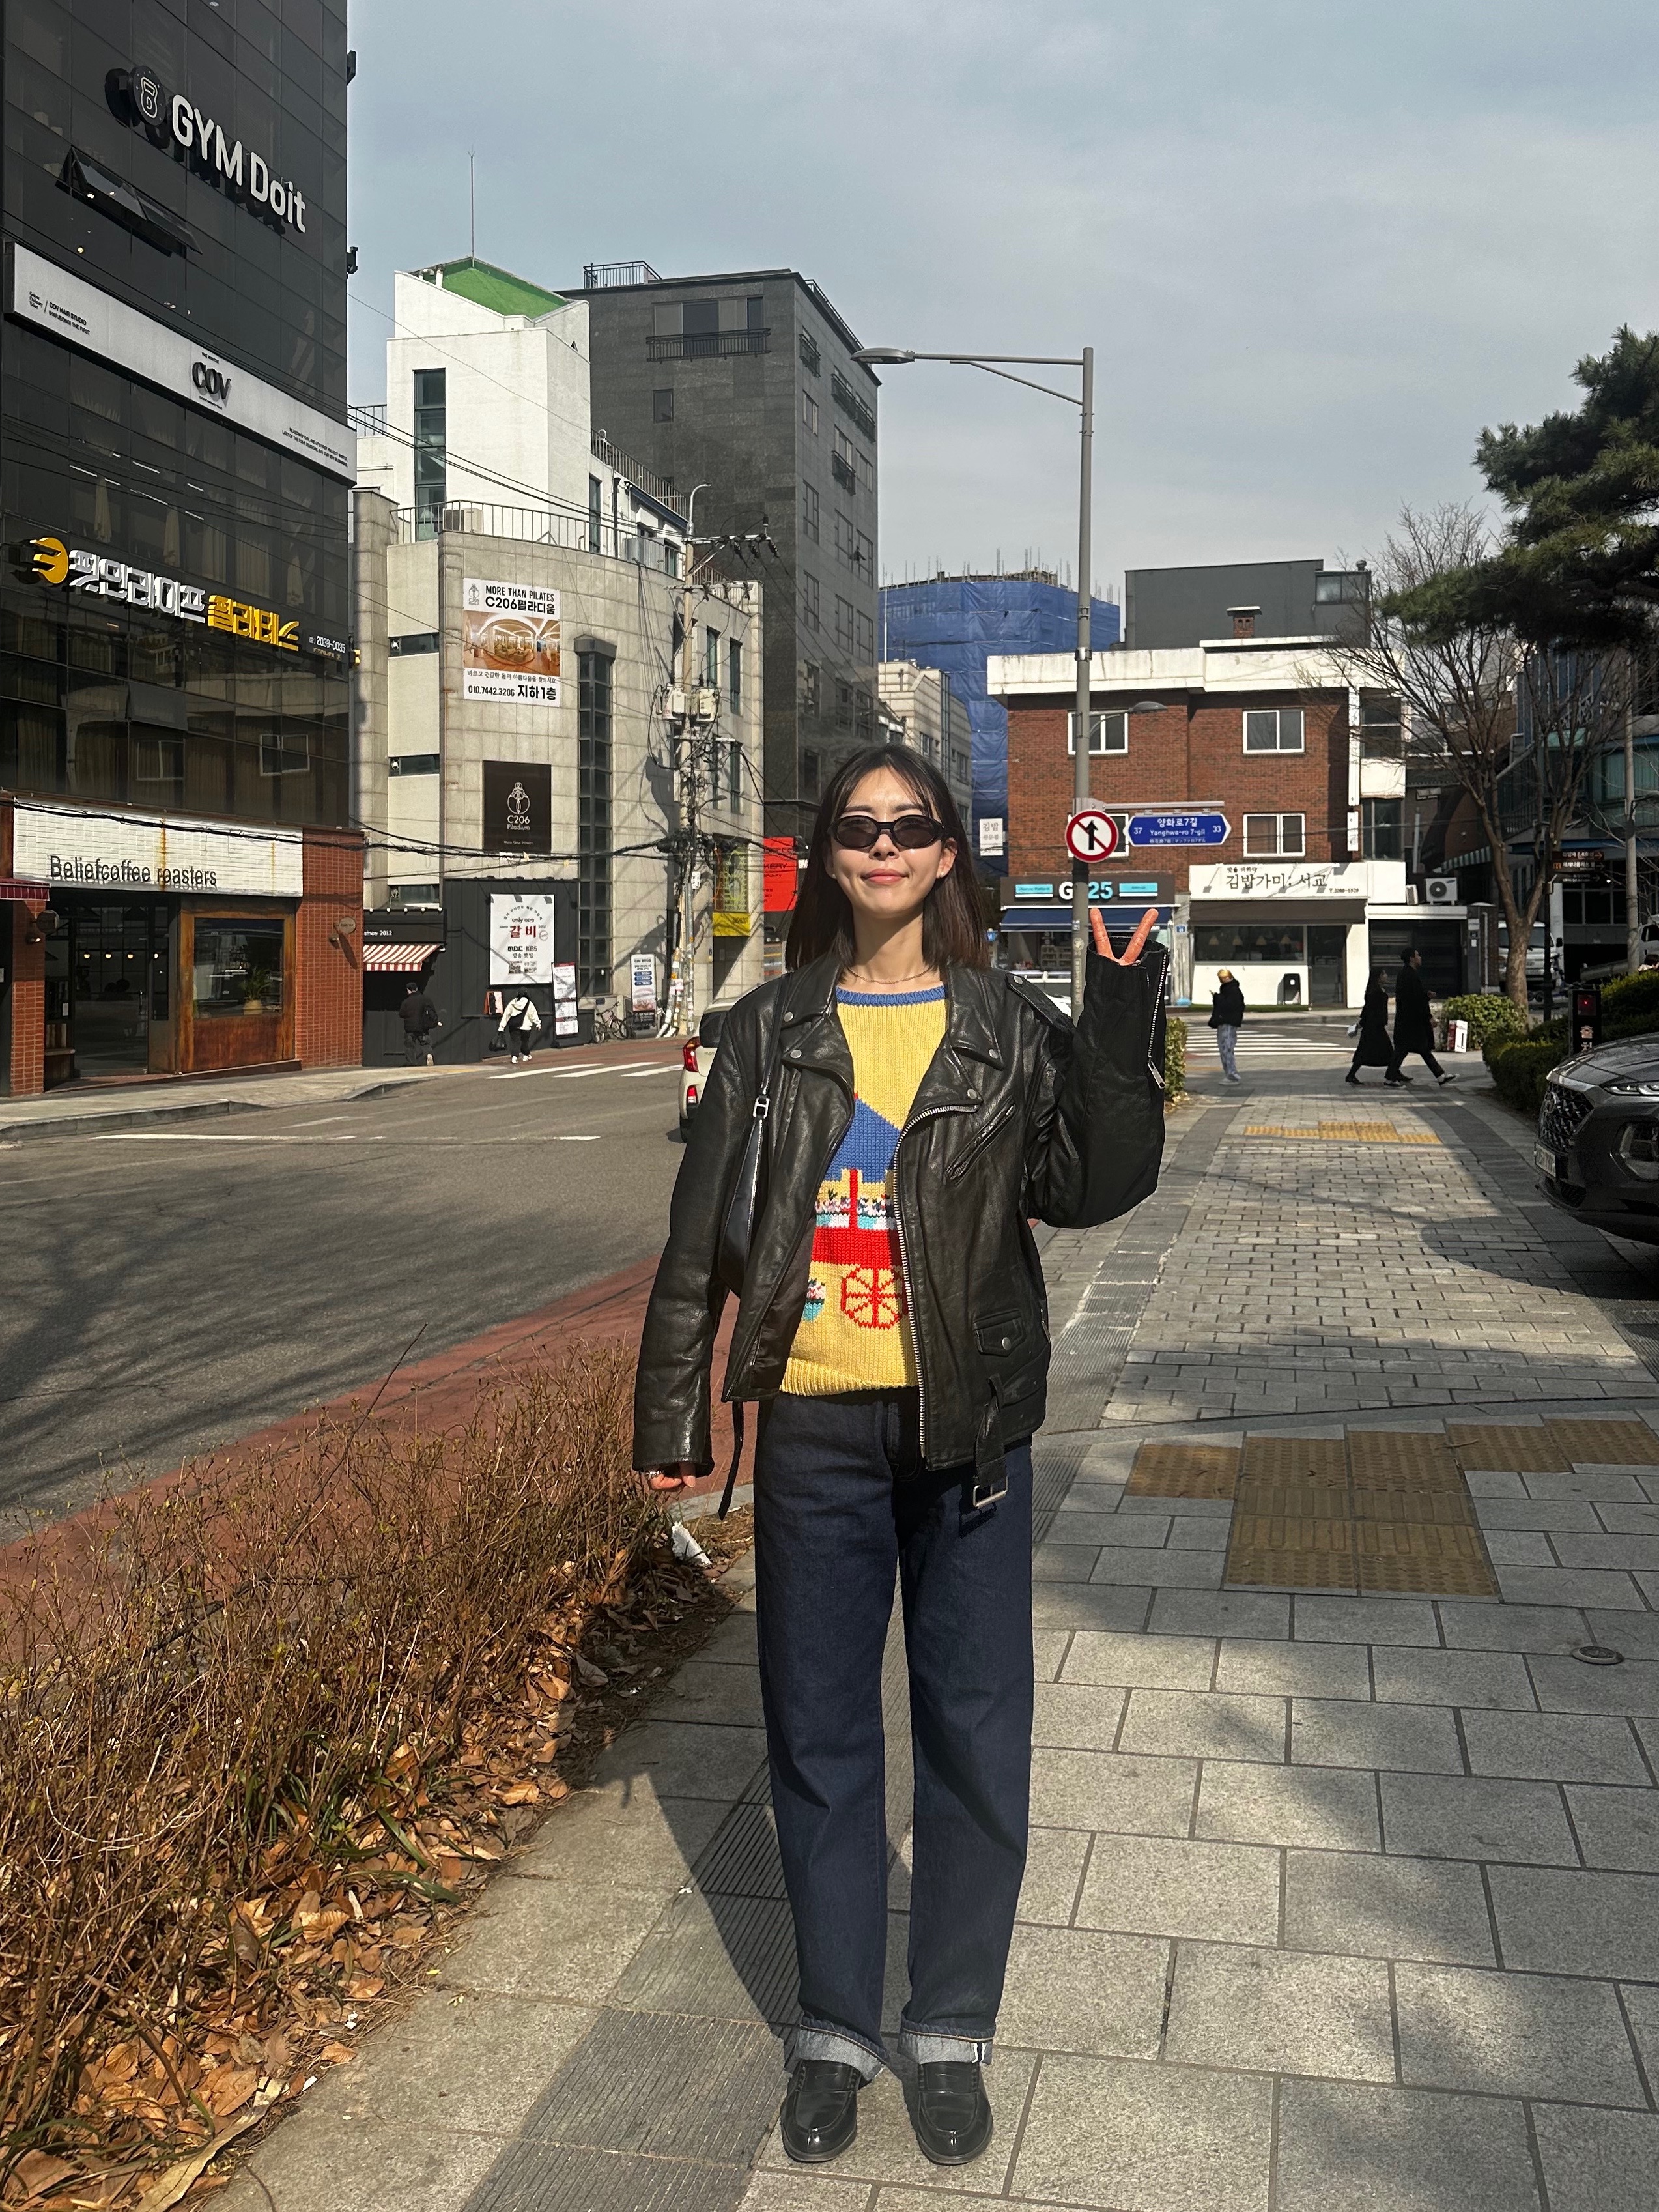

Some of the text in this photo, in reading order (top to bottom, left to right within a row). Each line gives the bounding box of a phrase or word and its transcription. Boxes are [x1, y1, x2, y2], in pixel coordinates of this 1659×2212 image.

[173, 94, 306, 233] GYM Doit
[70, 313, 87, 326] STUDIO
[192, 362, 231, 400] COV
[485, 585, 554, 603] MORE THAN PILATES
[485, 596, 556, 615] C206필라디움
[208, 594, 300, 652] 필라테스
[517, 685, 556, 700] 지하1층
[507, 814, 530, 824] C206
[983, 822, 999, 831] 김밥
[1157, 817, 1197, 828] 양화로7길
[50, 855, 217, 886] Beliefcoffee roasters
[1299, 873, 1327, 889] 서교
[1058, 882, 1113, 900] G25
